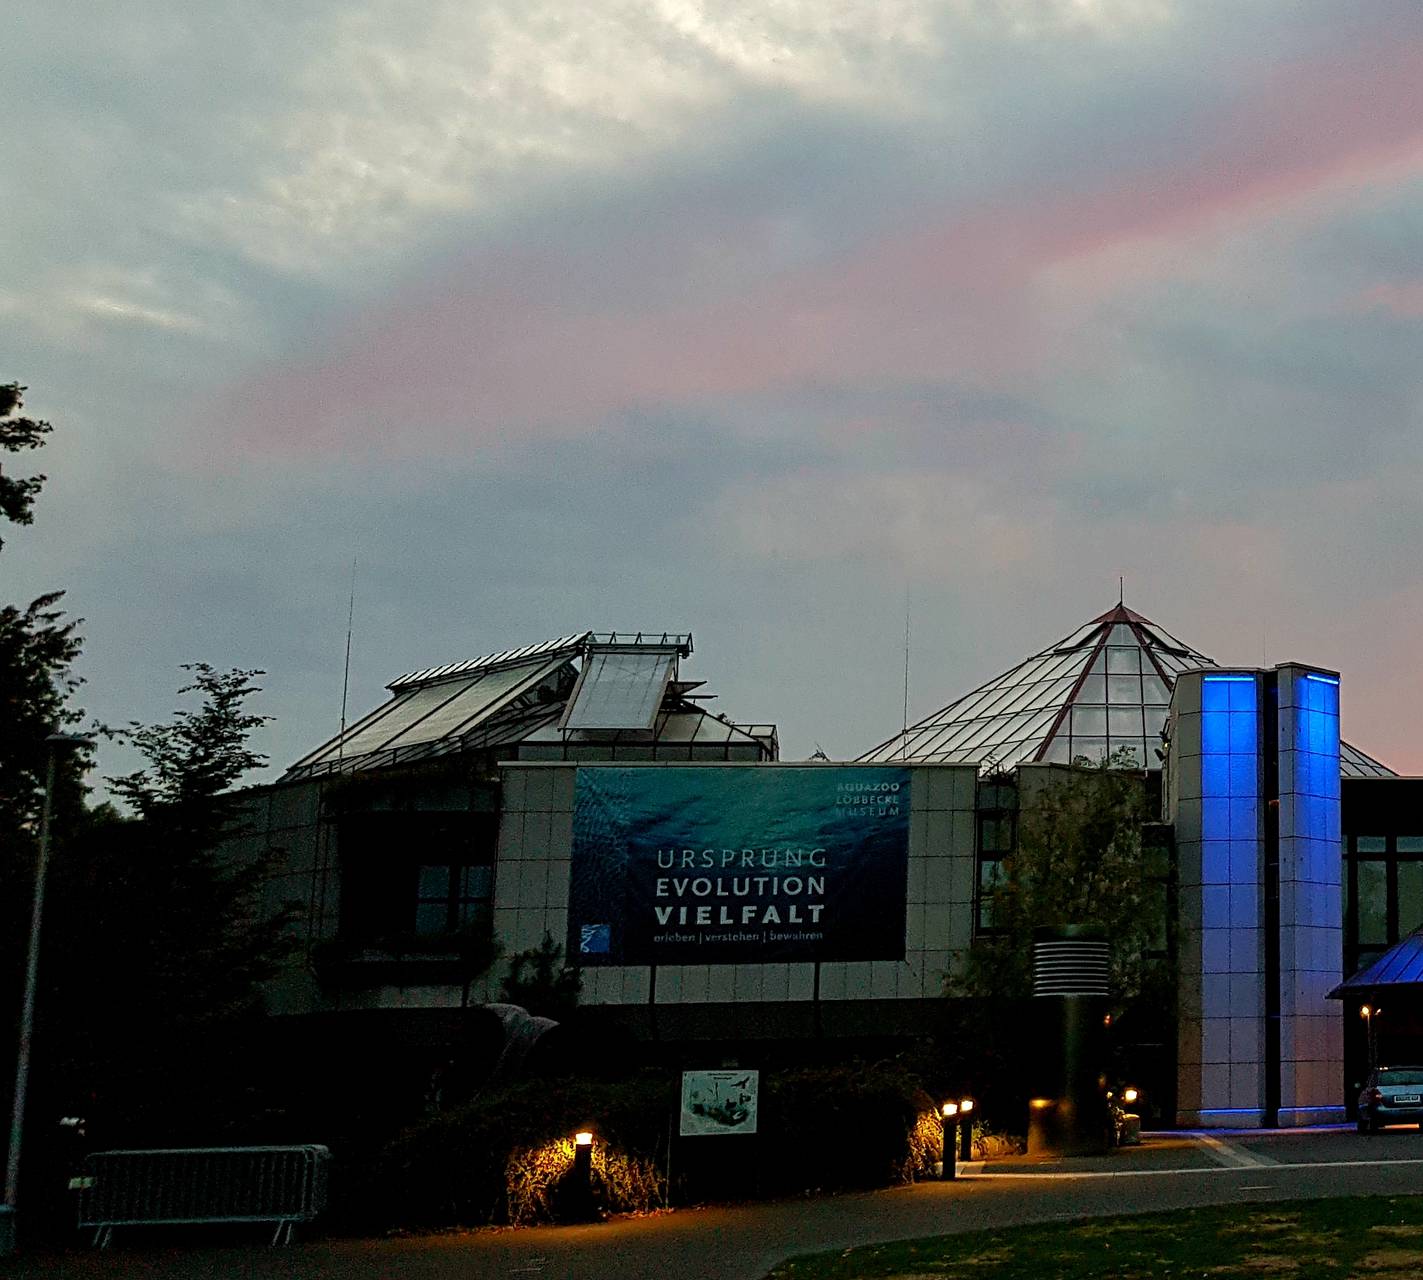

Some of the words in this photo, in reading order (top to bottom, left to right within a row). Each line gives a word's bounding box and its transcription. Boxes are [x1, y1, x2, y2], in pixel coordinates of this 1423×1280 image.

[657, 849, 826, 869] URSPRUNG
[656, 877, 825, 897] EVOLUTION
[654, 904, 825, 925] VIELFALT
[653, 932, 696, 943] erleben
[705, 931, 760, 942] verstehen
[770, 930, 824, 942] bewahren
